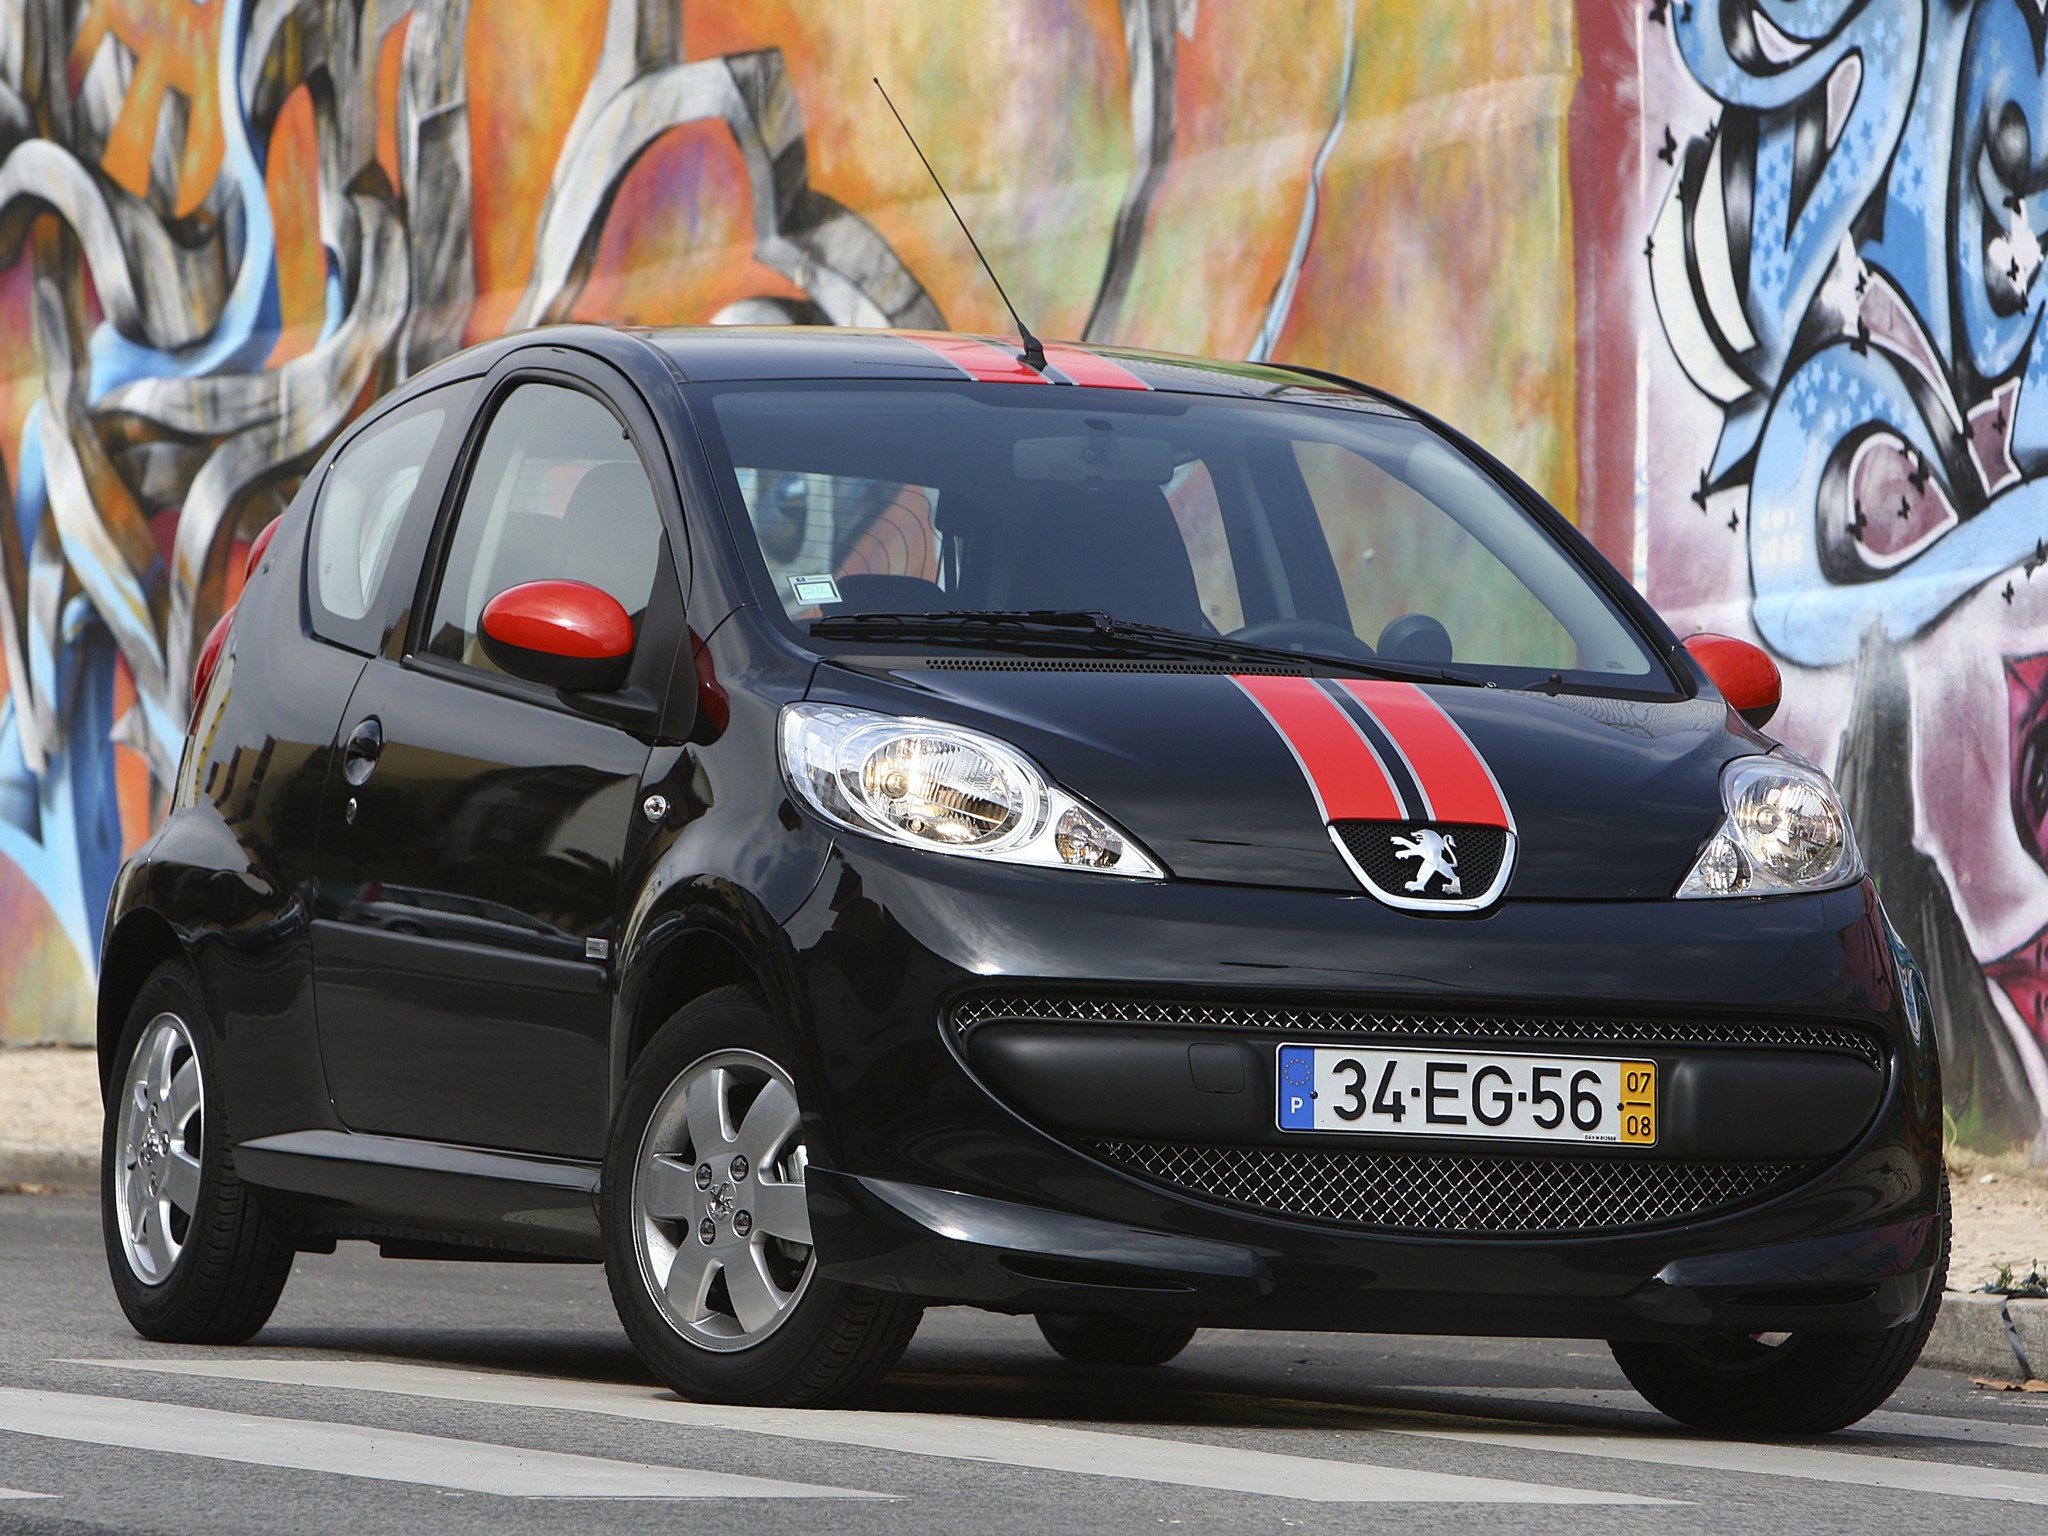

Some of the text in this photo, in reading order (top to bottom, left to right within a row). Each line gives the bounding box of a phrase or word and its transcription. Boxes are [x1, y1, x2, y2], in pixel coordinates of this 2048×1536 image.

[1627, 1071, 1651, 1093] 07
[1290, 1096, 1304, 1114] P
[1627, 1115, 1651, 1136] 08
